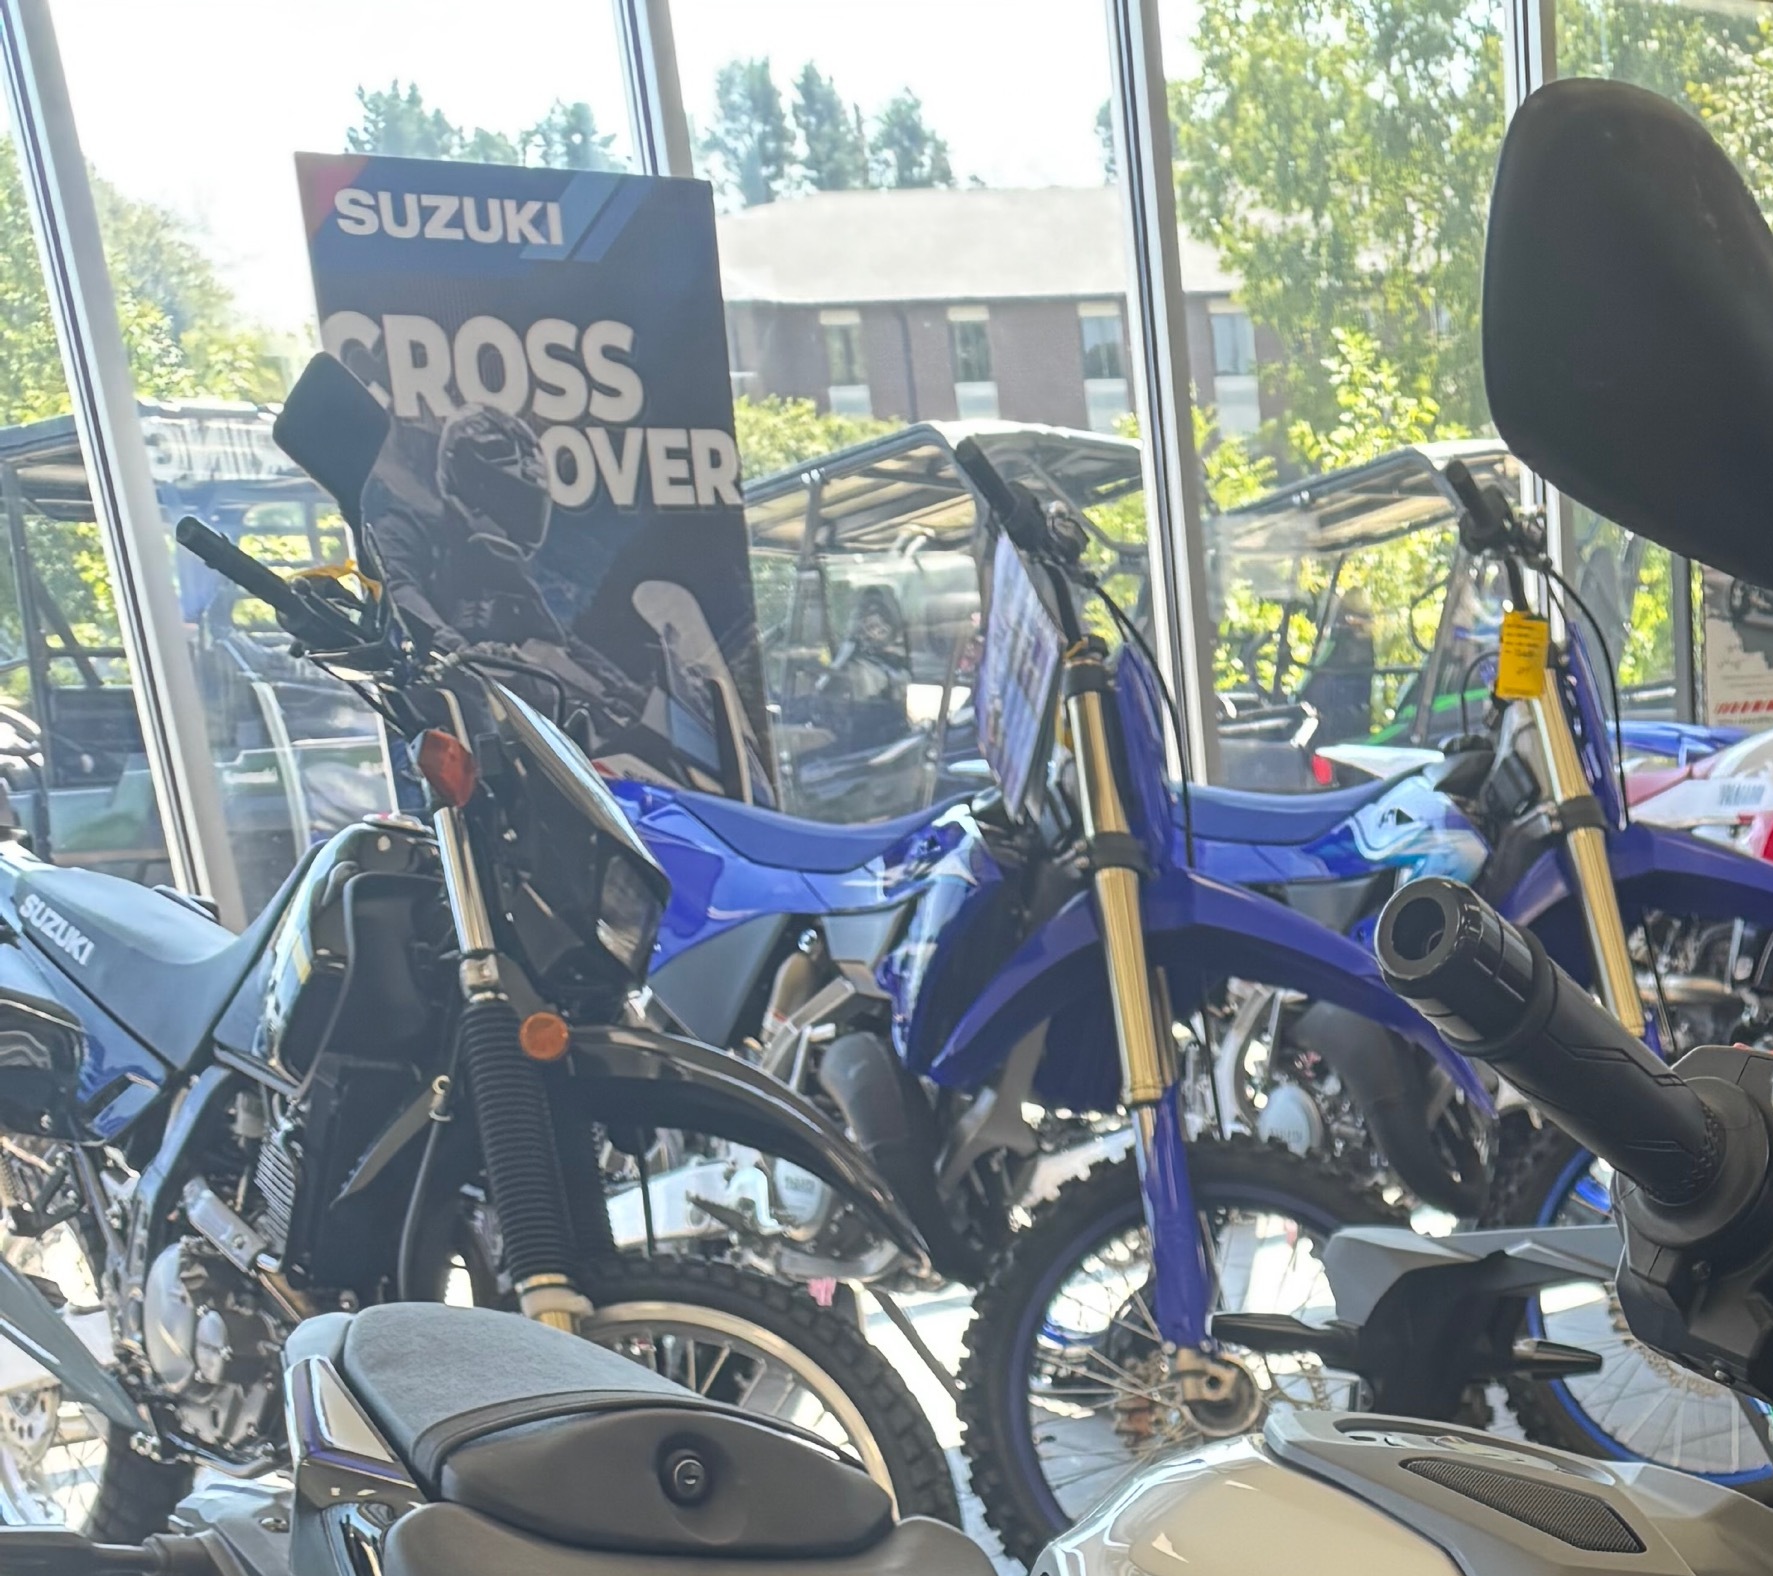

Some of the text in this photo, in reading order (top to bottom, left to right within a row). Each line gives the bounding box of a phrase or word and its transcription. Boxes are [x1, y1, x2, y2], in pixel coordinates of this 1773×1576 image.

[335, 187, 564, 246] SUZUKI
[323, 311, 644, 423] CROSS
[545, 426, 744, 508] OVER
[20, 894, 95, 967] SUZUKI
